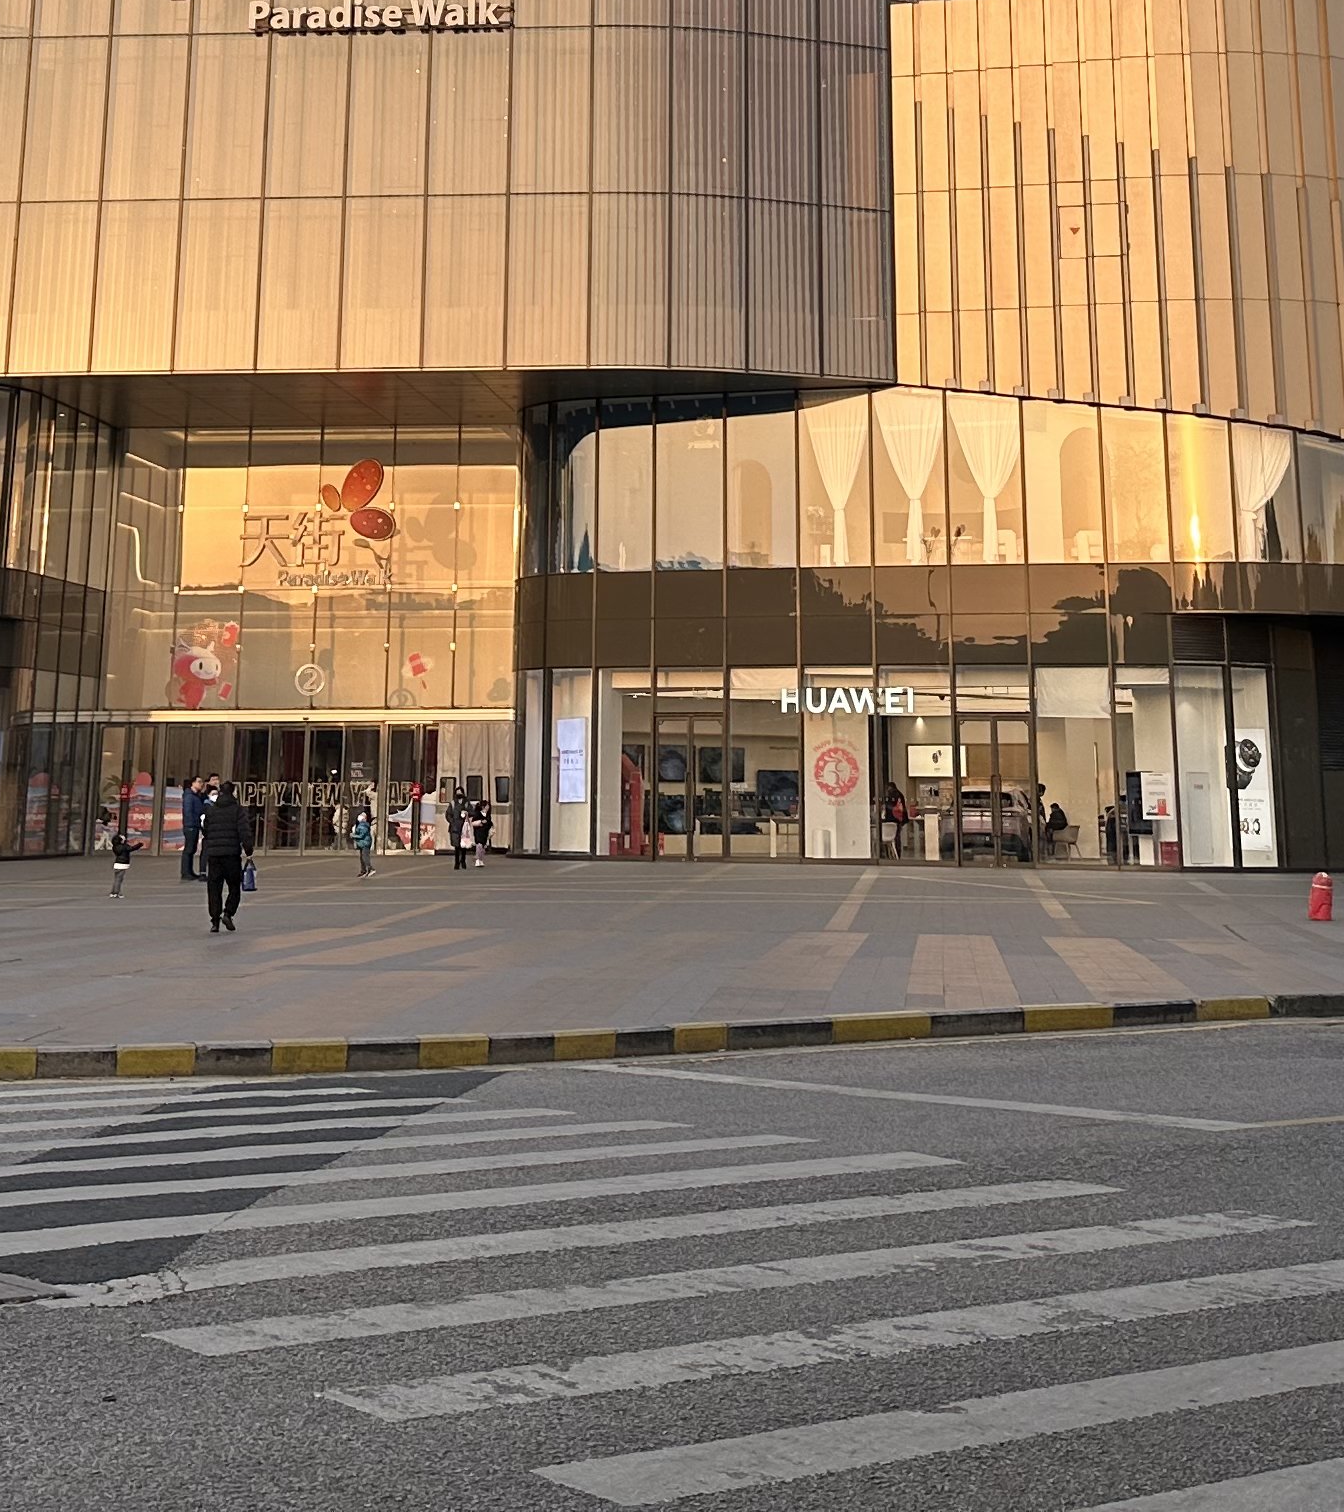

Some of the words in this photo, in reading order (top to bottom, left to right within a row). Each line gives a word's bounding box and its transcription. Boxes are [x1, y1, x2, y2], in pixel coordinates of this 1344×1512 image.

[238, 512, 348, 568] 天街
[278, 568, 349, 587] Paradise
[350, 568, 393, 586] Walk
[781, 687, 914, 714] HUAWEI
[233, 781, 288, 807] APPY
[291, 781, 346, 808] NEW
